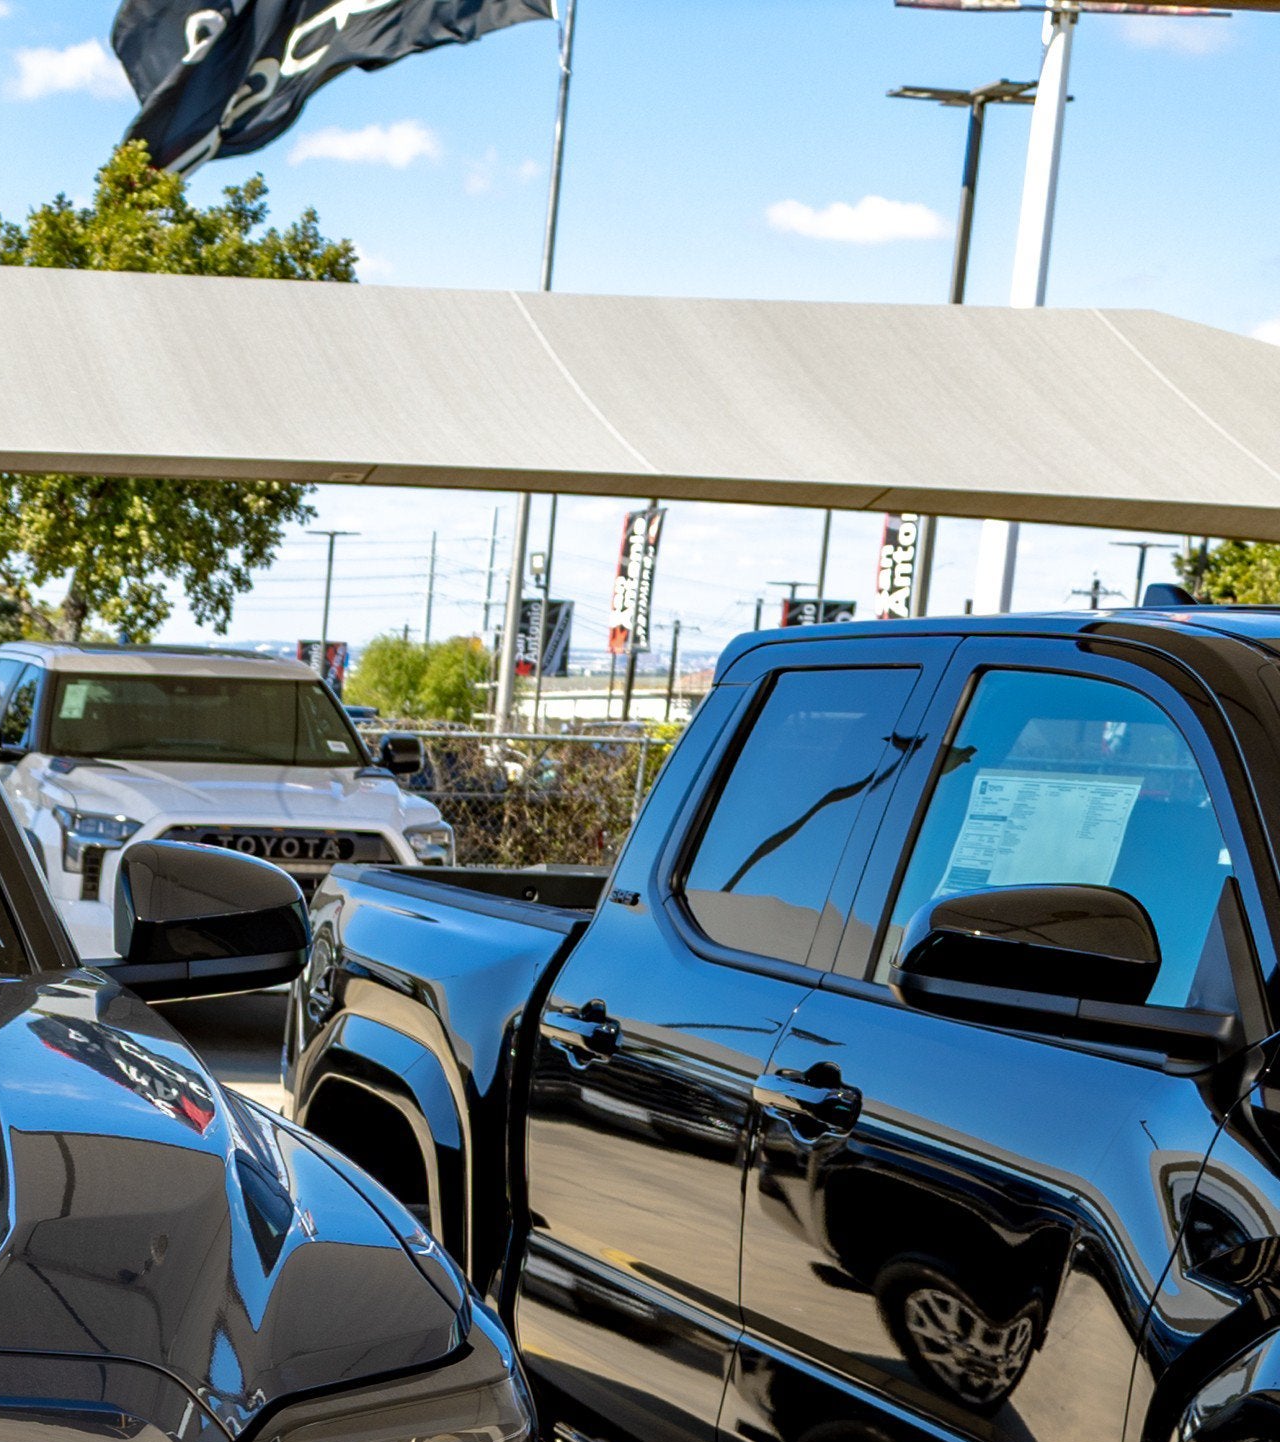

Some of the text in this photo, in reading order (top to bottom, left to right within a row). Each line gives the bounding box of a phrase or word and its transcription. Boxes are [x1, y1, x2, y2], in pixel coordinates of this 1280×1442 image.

[889, 513, 918, 617] Anto
[527, 603, 541, 664] Antonio
[217, 836, 340, 860] TOYOTA
